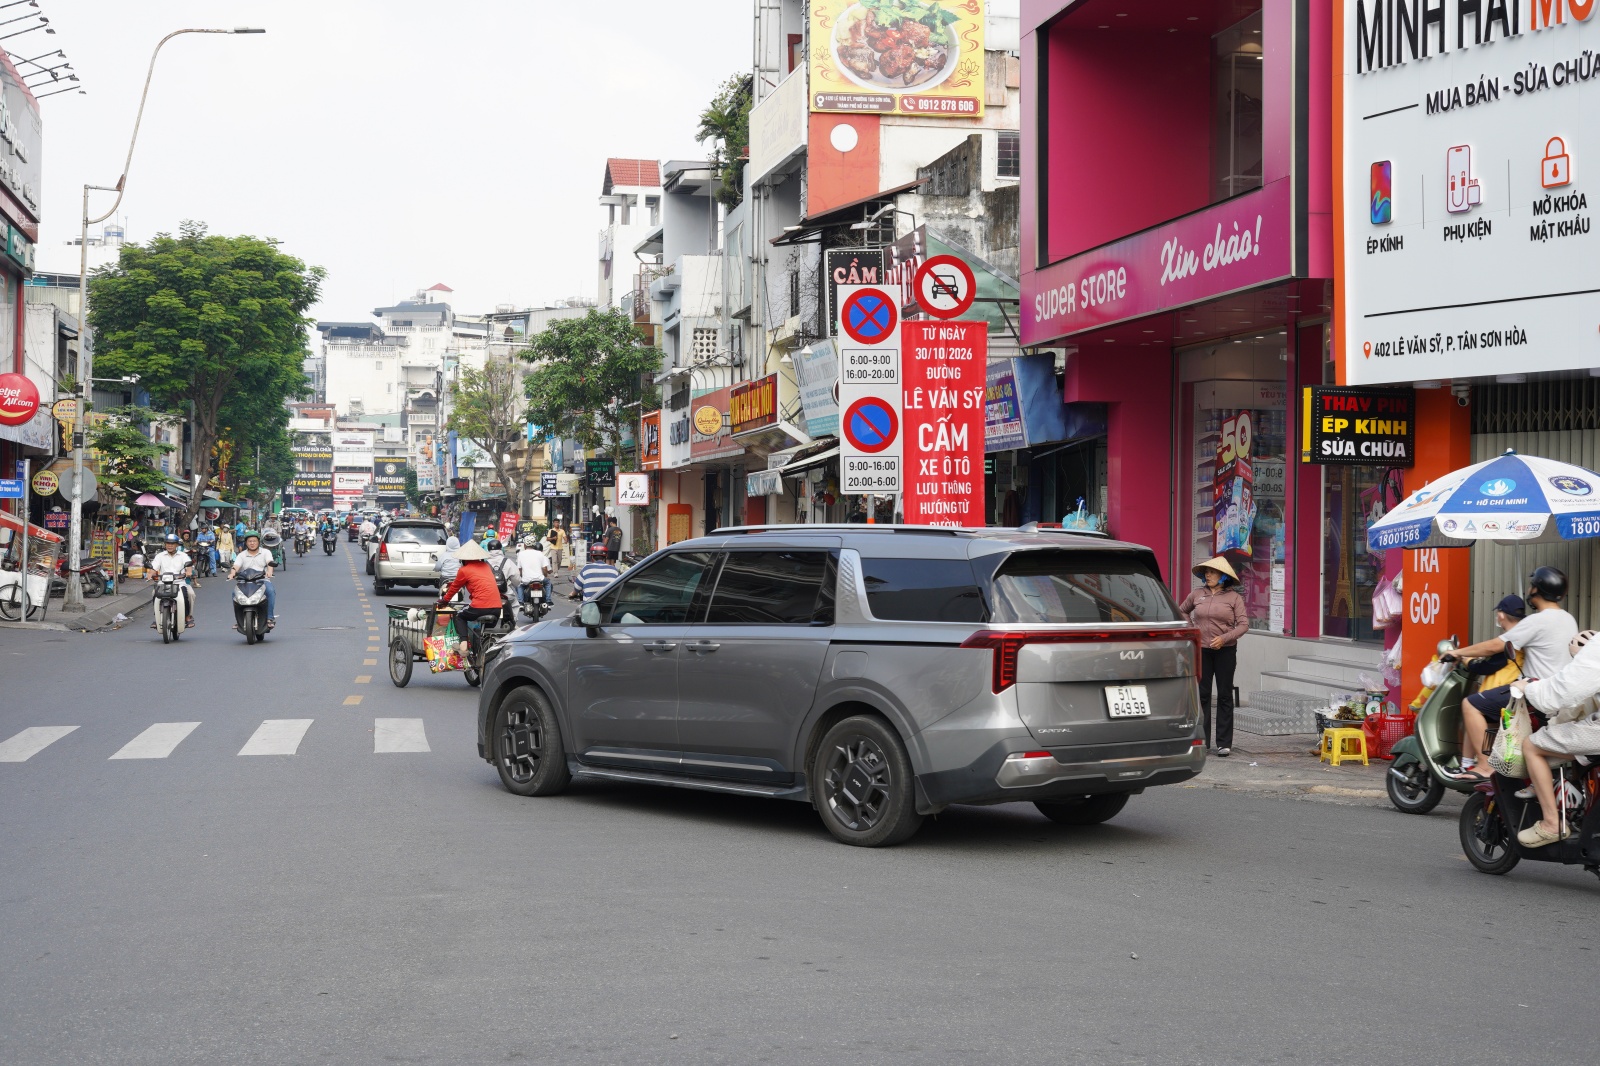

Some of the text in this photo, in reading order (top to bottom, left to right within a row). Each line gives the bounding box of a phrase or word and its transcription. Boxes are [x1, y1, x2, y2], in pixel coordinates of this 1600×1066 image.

[1427, 87, 1462, 115] MUA
[1466, 74, 1499, 106] BÁN
[1514, 62, 1549, 95] SỬA
[919, 99, 974, 112] 0912 878 606
[1533, 191, 1587, 216] MỞ KHÓA
[1444, 217, 1492, 243] PHỤ KIỆN
[1530, 215, 1590, 243] MẬT KHẨU
[1160, 215, 1262, 286] Xin chào!
[1367, 235, 1404, 255] ÉP KÍNH
[922, 325, 966, 340] TỪ NGÀY
[1374, 325, 1527, 357] 402 LÊ VĂN SỸ, P. TÂN SƠN HÒA
[915, 347, 972, 360] 30/10/2026
[846, 369, 895, 379] 16:00-20:00
[926, 365, 961, 380] ĐƯỜNG
[904, 386, 983, 409] LÊ VĂN SỸ
[1322, 395, 1408, 413] THAY PIN
[918, 414, 968, 452] CẤM
[1322, 415, 1407, 435] ÉP KÍNH
[1321, 437, 1406, 457] SỬA CHỮA
[849, 461, 896, 471] 9:00-16:00
[920, 456, 971, 476] XE Ô TÔ
[418, 478, 433, 486] 7K
[848, 476, 897, 487] 20:00-6:00
[916, 480, 972, 495] LƯU THÔNG
[920, 498, 970, 514] HƯỚNG TỪ
[1489, 498, 1504, 506] CHÍ
[1379, 528, 1420, 546] 18001568
[1571, 521, 1600, 535] 1800
[1409, 583, 1440, 625] GÓP
[1118, 688, 1136, 701] 51L
[1114, 701, 1146, 715] 849.98
